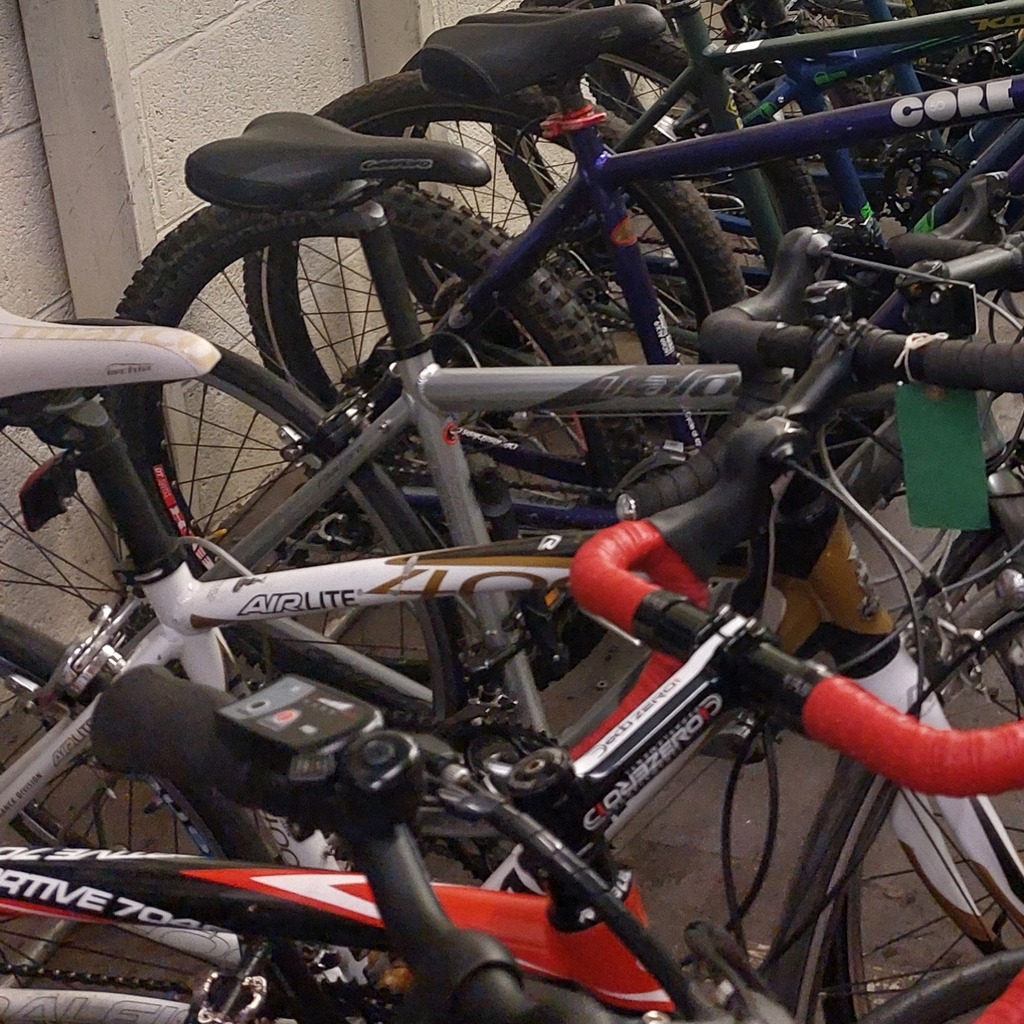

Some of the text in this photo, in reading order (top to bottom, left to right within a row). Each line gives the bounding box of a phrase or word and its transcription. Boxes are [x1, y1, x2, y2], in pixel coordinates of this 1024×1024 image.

[890, 79, 1016, 127] CORE
[238, 589, 356, 617] AIRLITE
[0, 867, 114, 913] RTIVE
